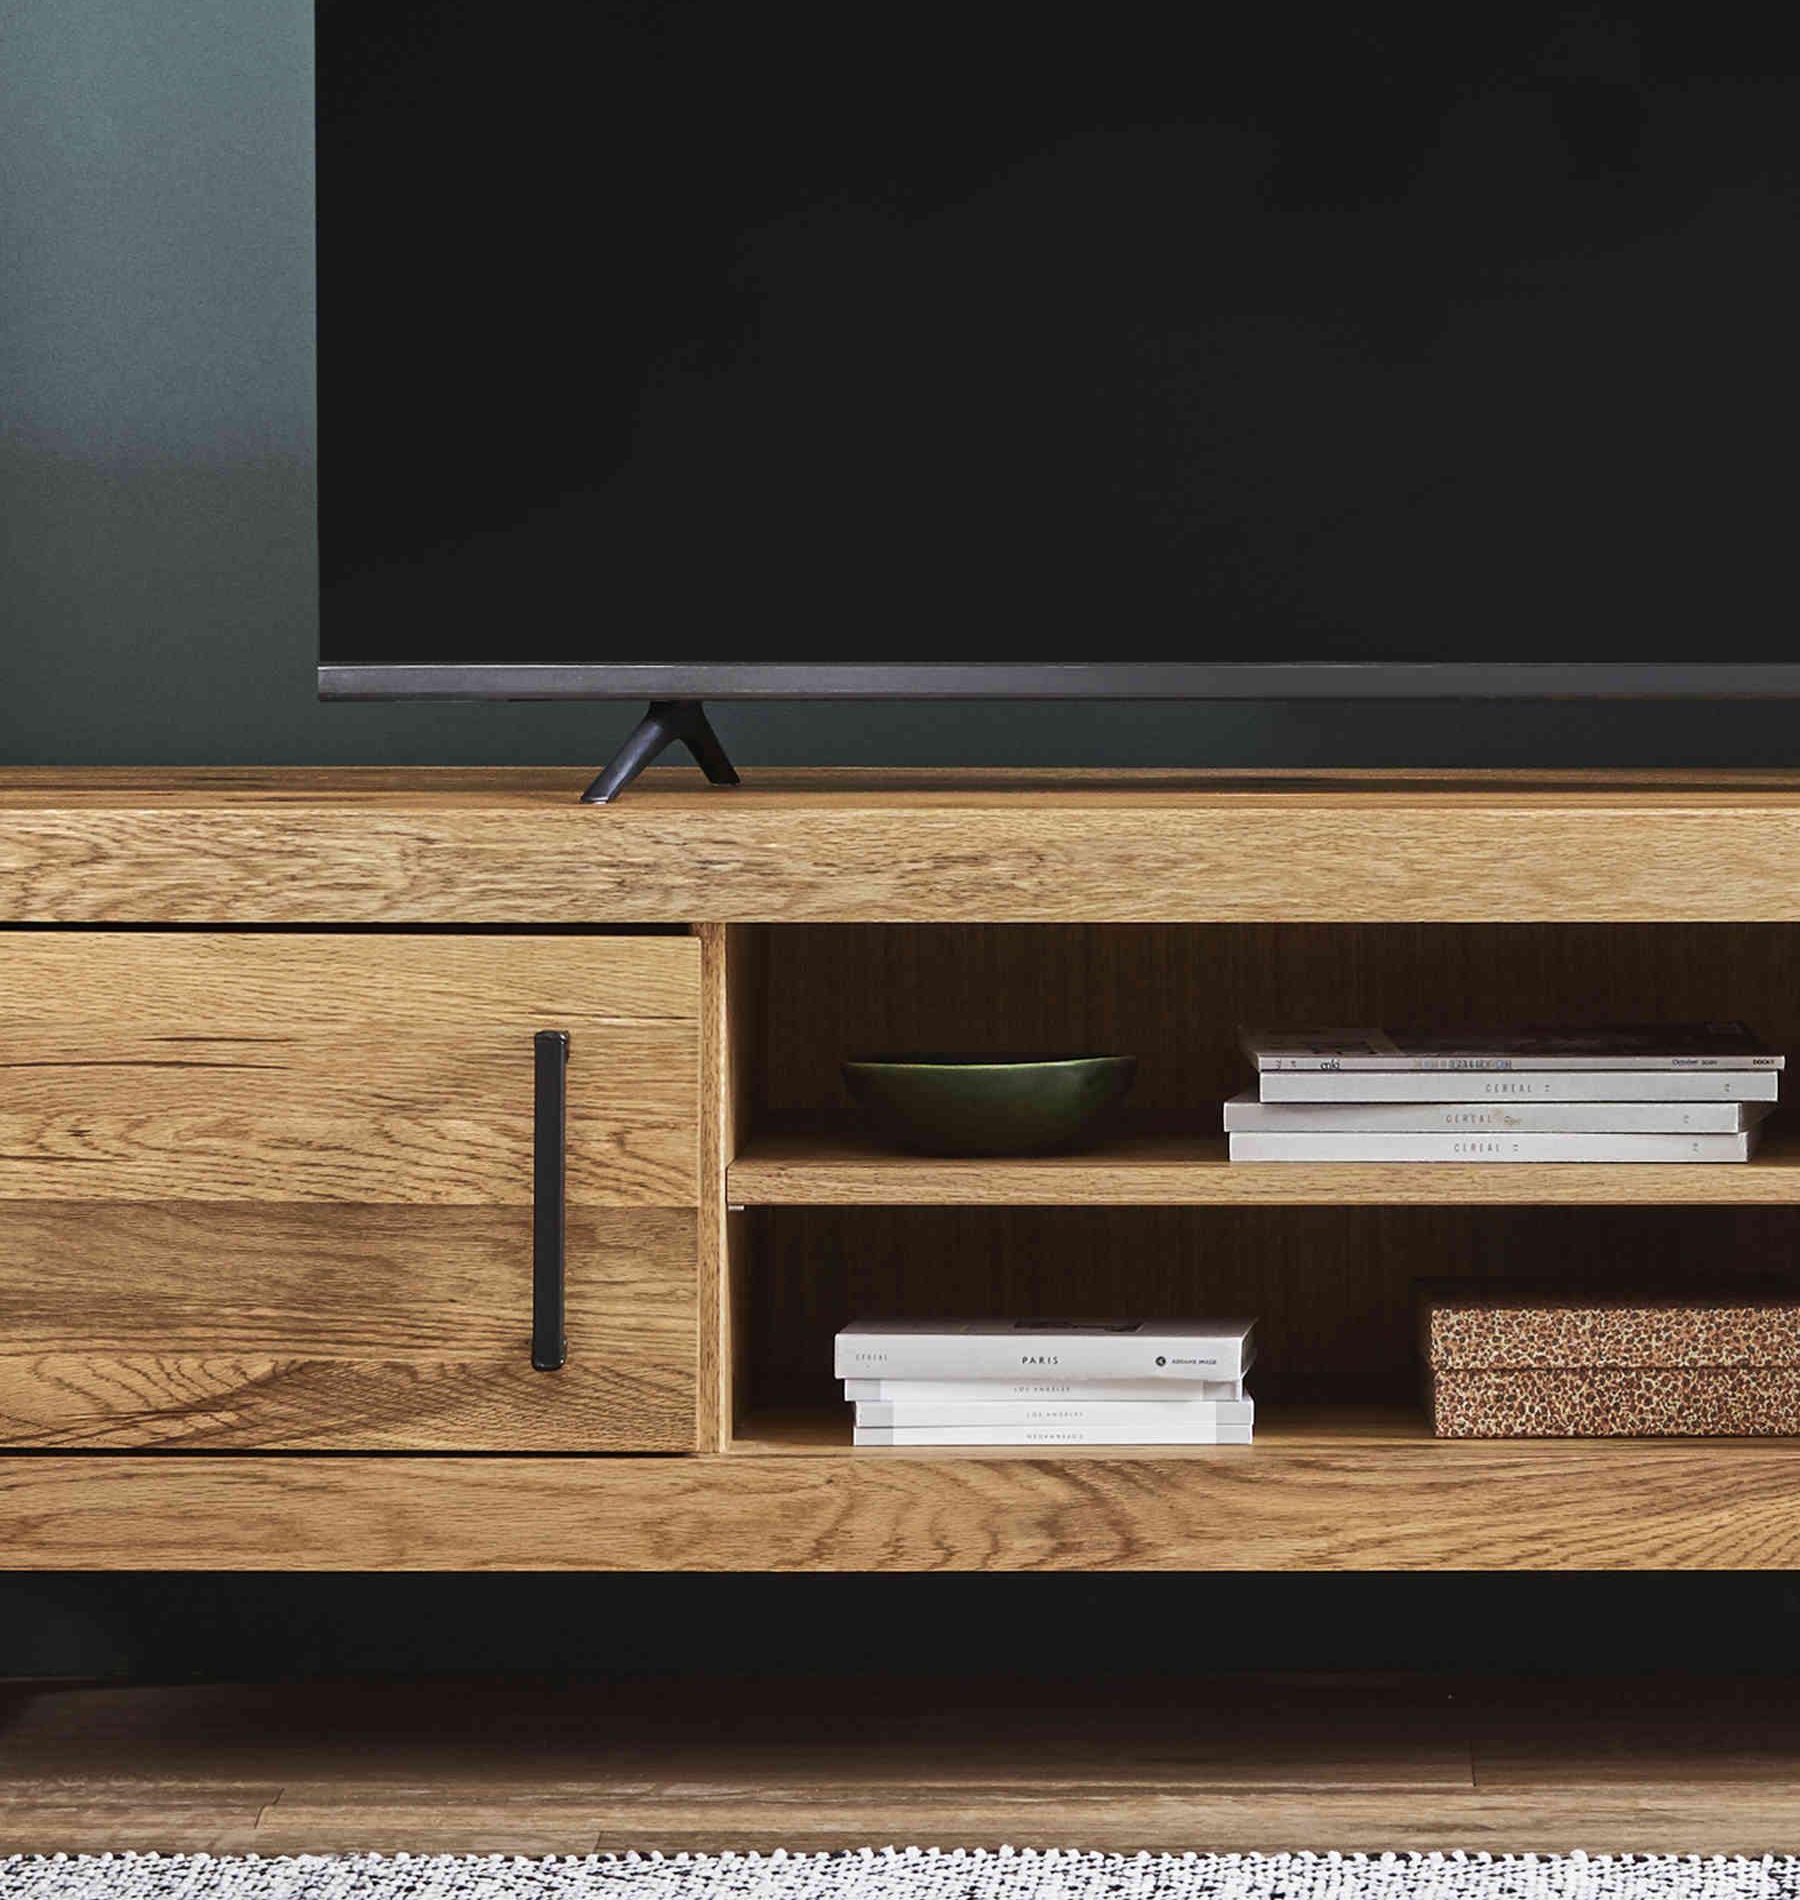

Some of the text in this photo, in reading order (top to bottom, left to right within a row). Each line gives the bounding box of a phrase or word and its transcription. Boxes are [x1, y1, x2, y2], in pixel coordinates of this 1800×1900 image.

[1485, 1083, 1533, 1093] CEREAL
[1446, 1114, 1492, 1123] CEREAL
[1454, 1143, 1500, 1153] CEREAL
[1021, 1356, 1059, 1365] PARIS
